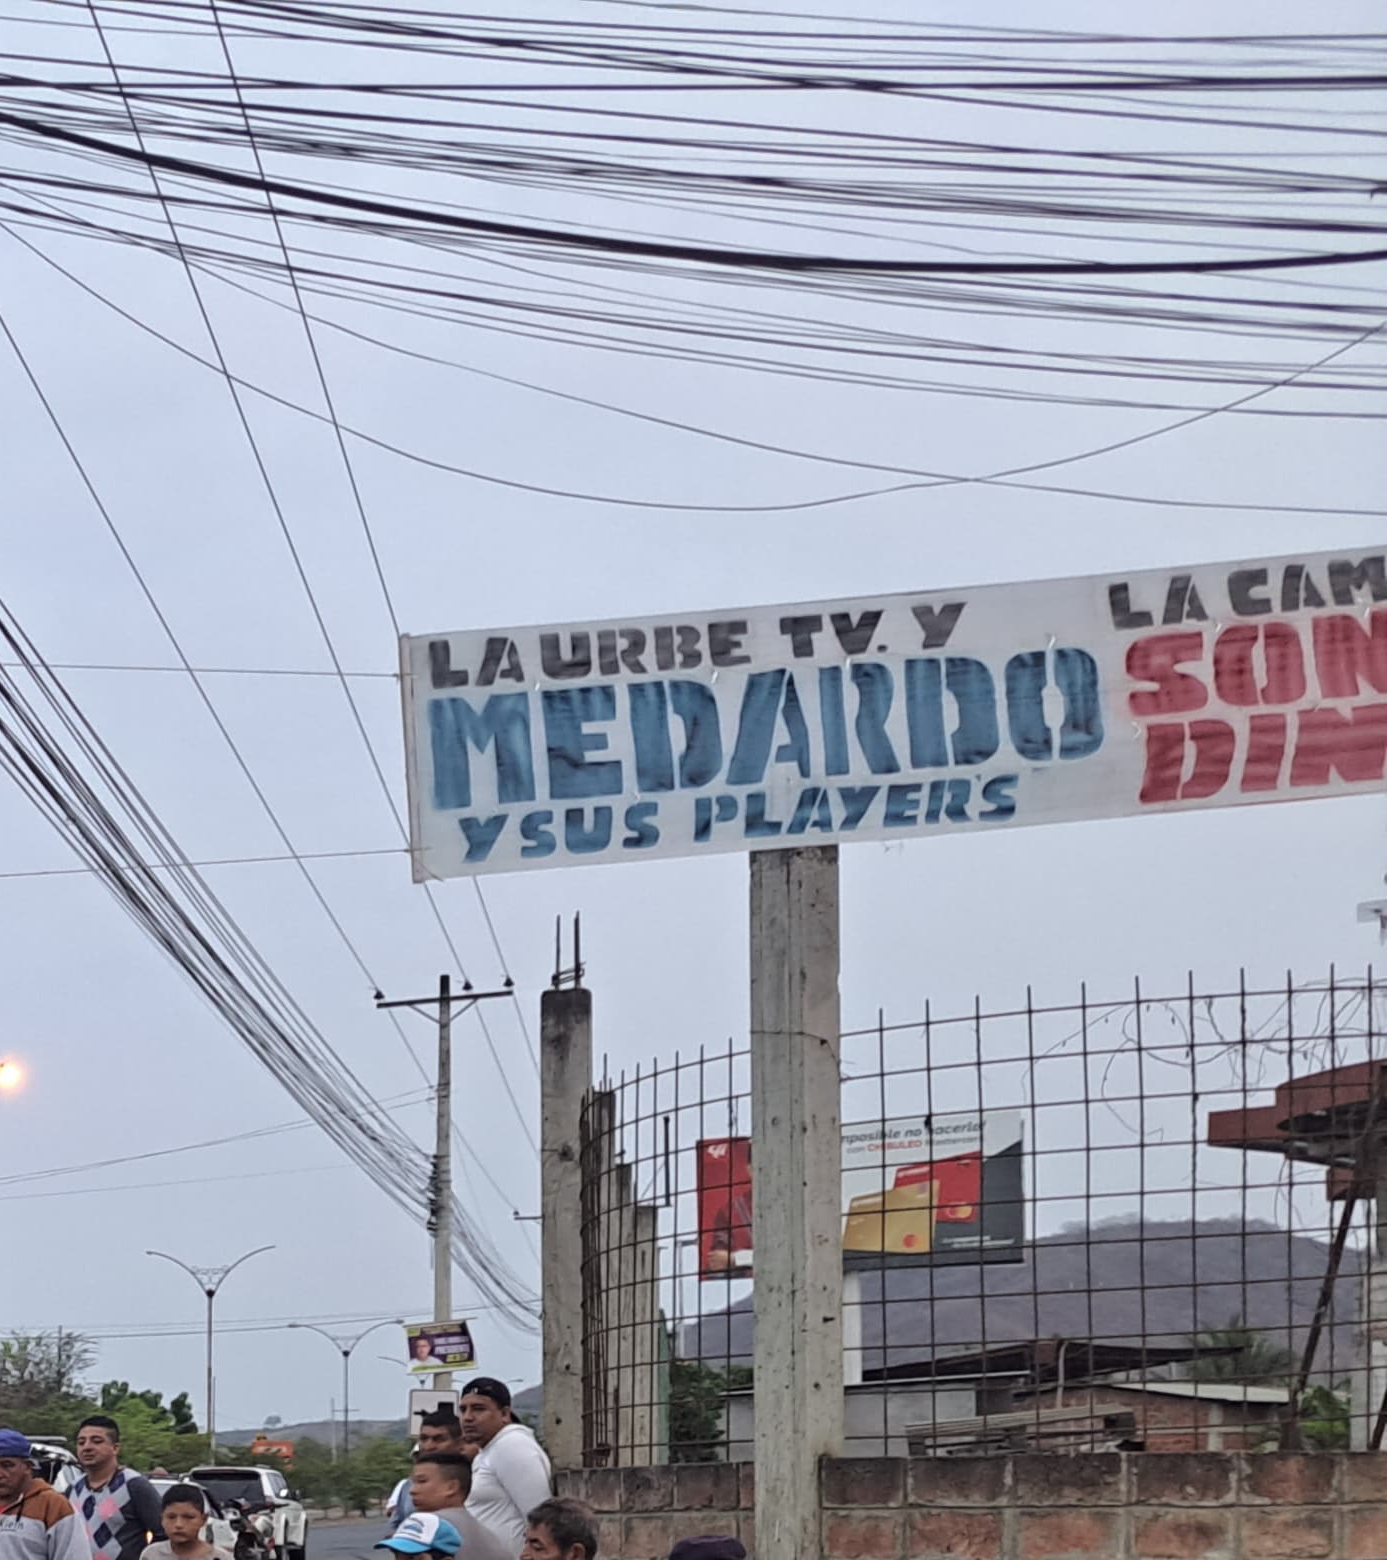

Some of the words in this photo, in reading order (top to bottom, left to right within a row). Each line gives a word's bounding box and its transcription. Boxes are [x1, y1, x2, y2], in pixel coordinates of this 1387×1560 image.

[538, 619, 752, 679] URBE
[778, 609, 888, 659] TV.
[911, 602, 967, 649] Y
[1107, 574, 1209, 631] LA
[430, 647, 1105, 811] MEDARDO
